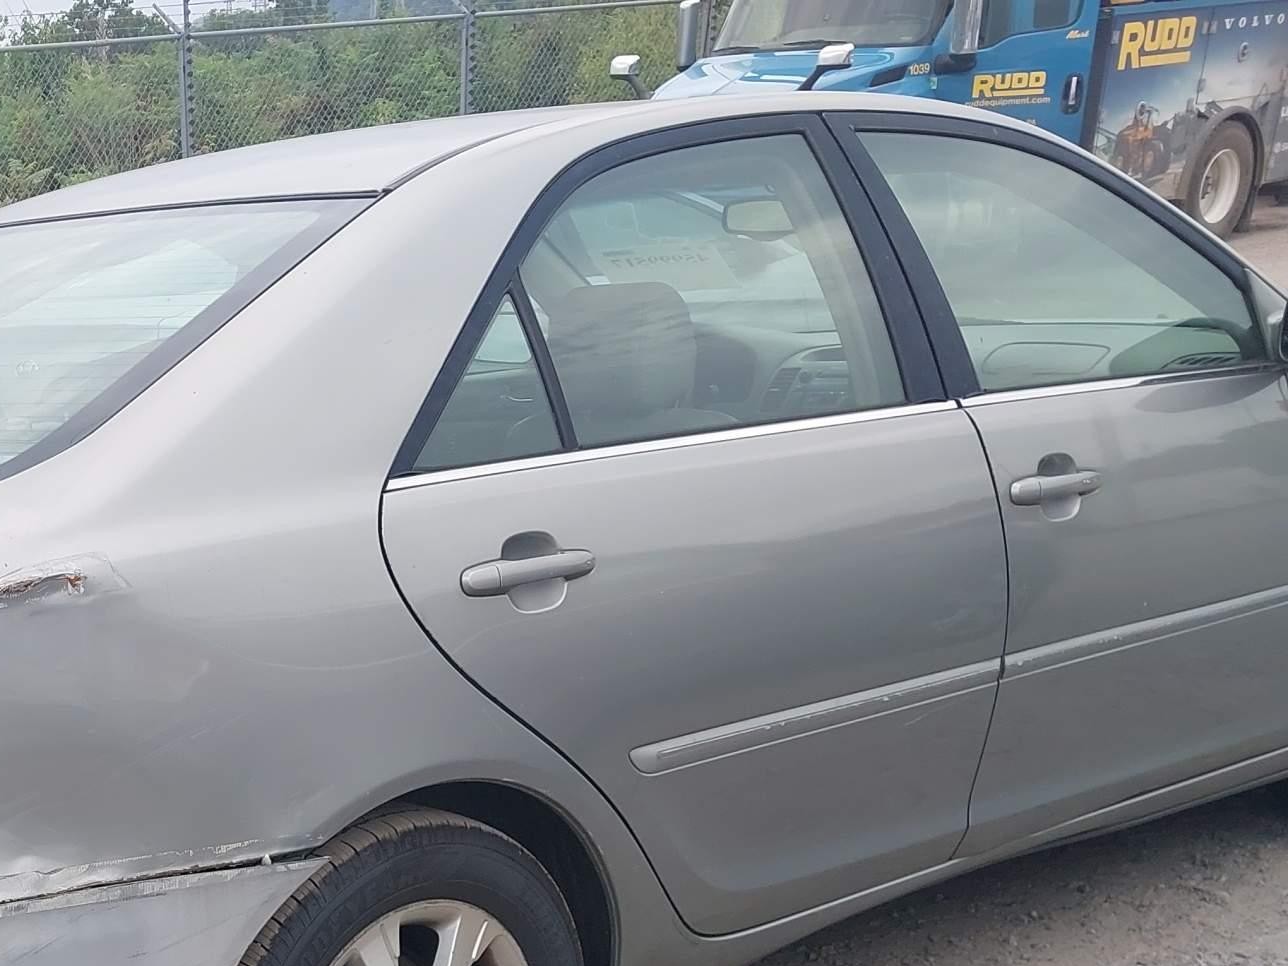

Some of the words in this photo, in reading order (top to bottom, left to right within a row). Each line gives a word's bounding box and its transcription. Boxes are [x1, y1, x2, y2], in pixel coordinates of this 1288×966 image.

[1224, 14, 1287, 30] VOLVO
[1117, 15, 1197, 71] RUDD
[908, 62, 930, 76] 1039
[972, 71, 1047, 98] RUDD
